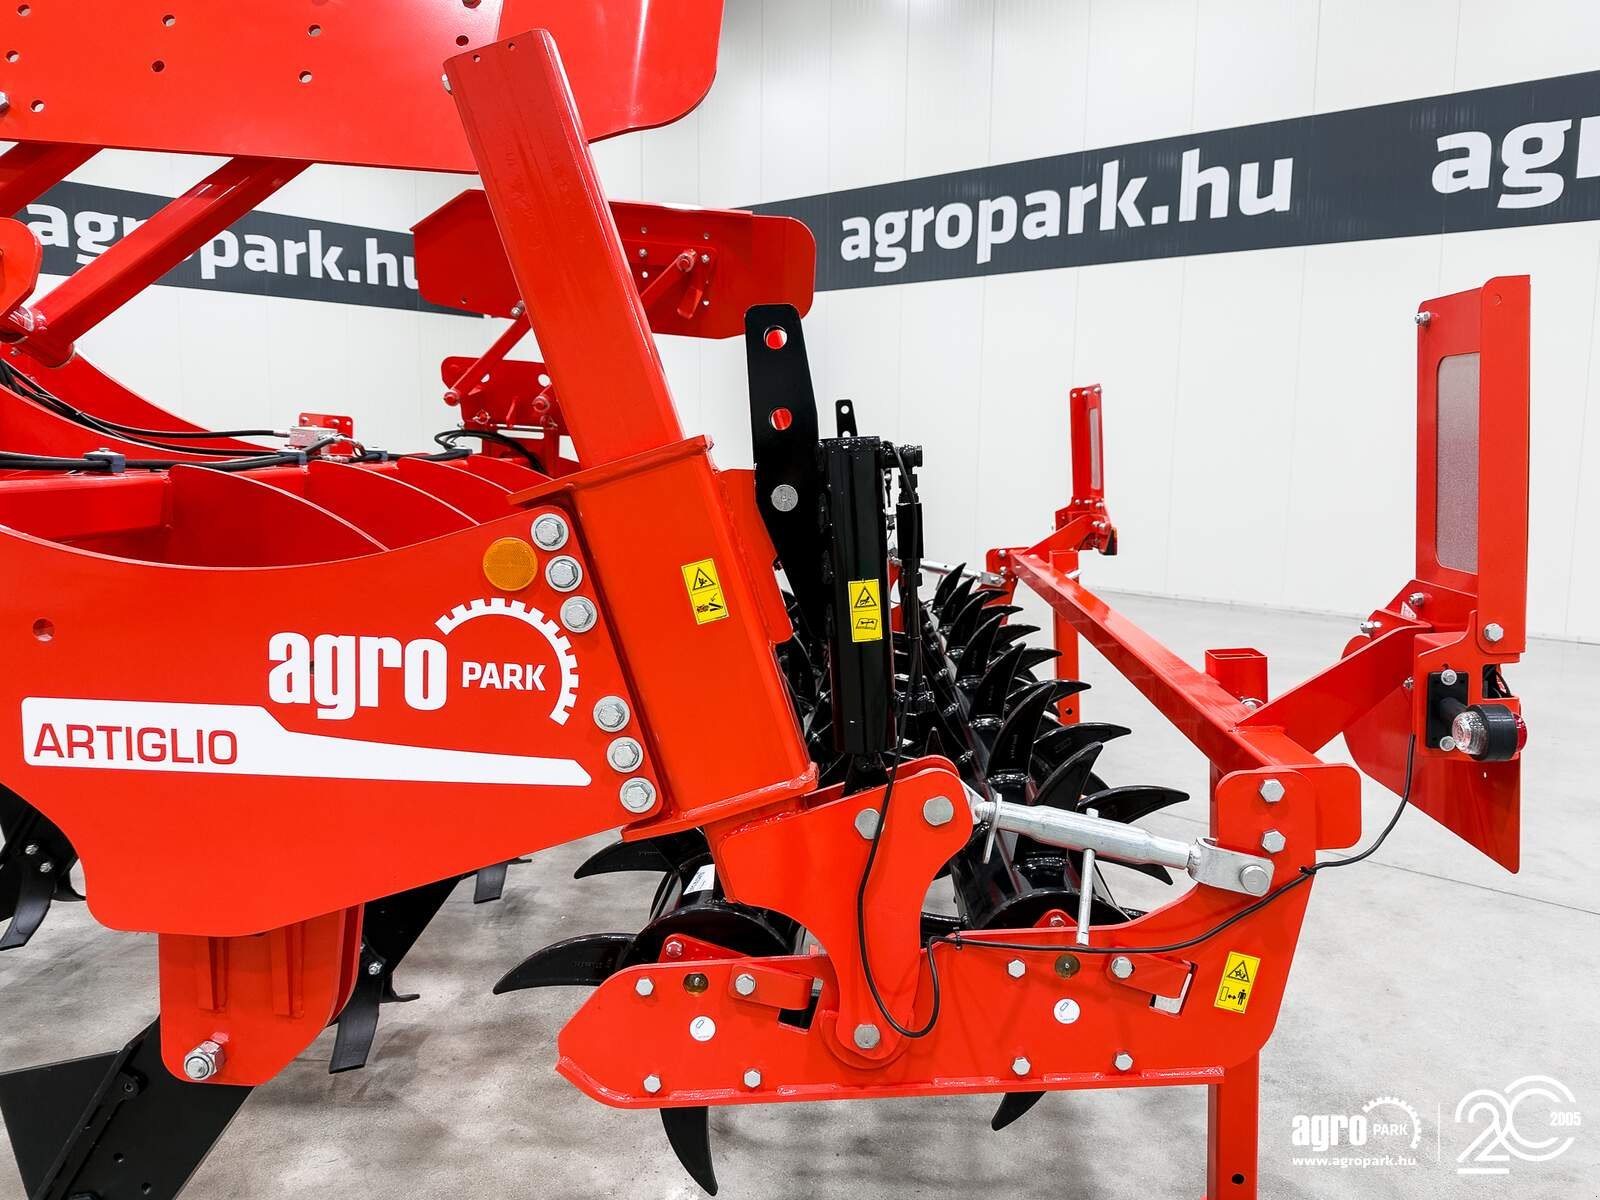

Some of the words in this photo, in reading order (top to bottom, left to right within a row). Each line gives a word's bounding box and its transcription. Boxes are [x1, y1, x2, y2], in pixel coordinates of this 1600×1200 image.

[26, 203, 419, 290] agpark.h
[840, 147, 1294, 273] agropark.hu
[269, 632, 447, 720] agro
[462, 661, 547, 691] PARK
[33, 723, 238, 765] ARTIGLIO
